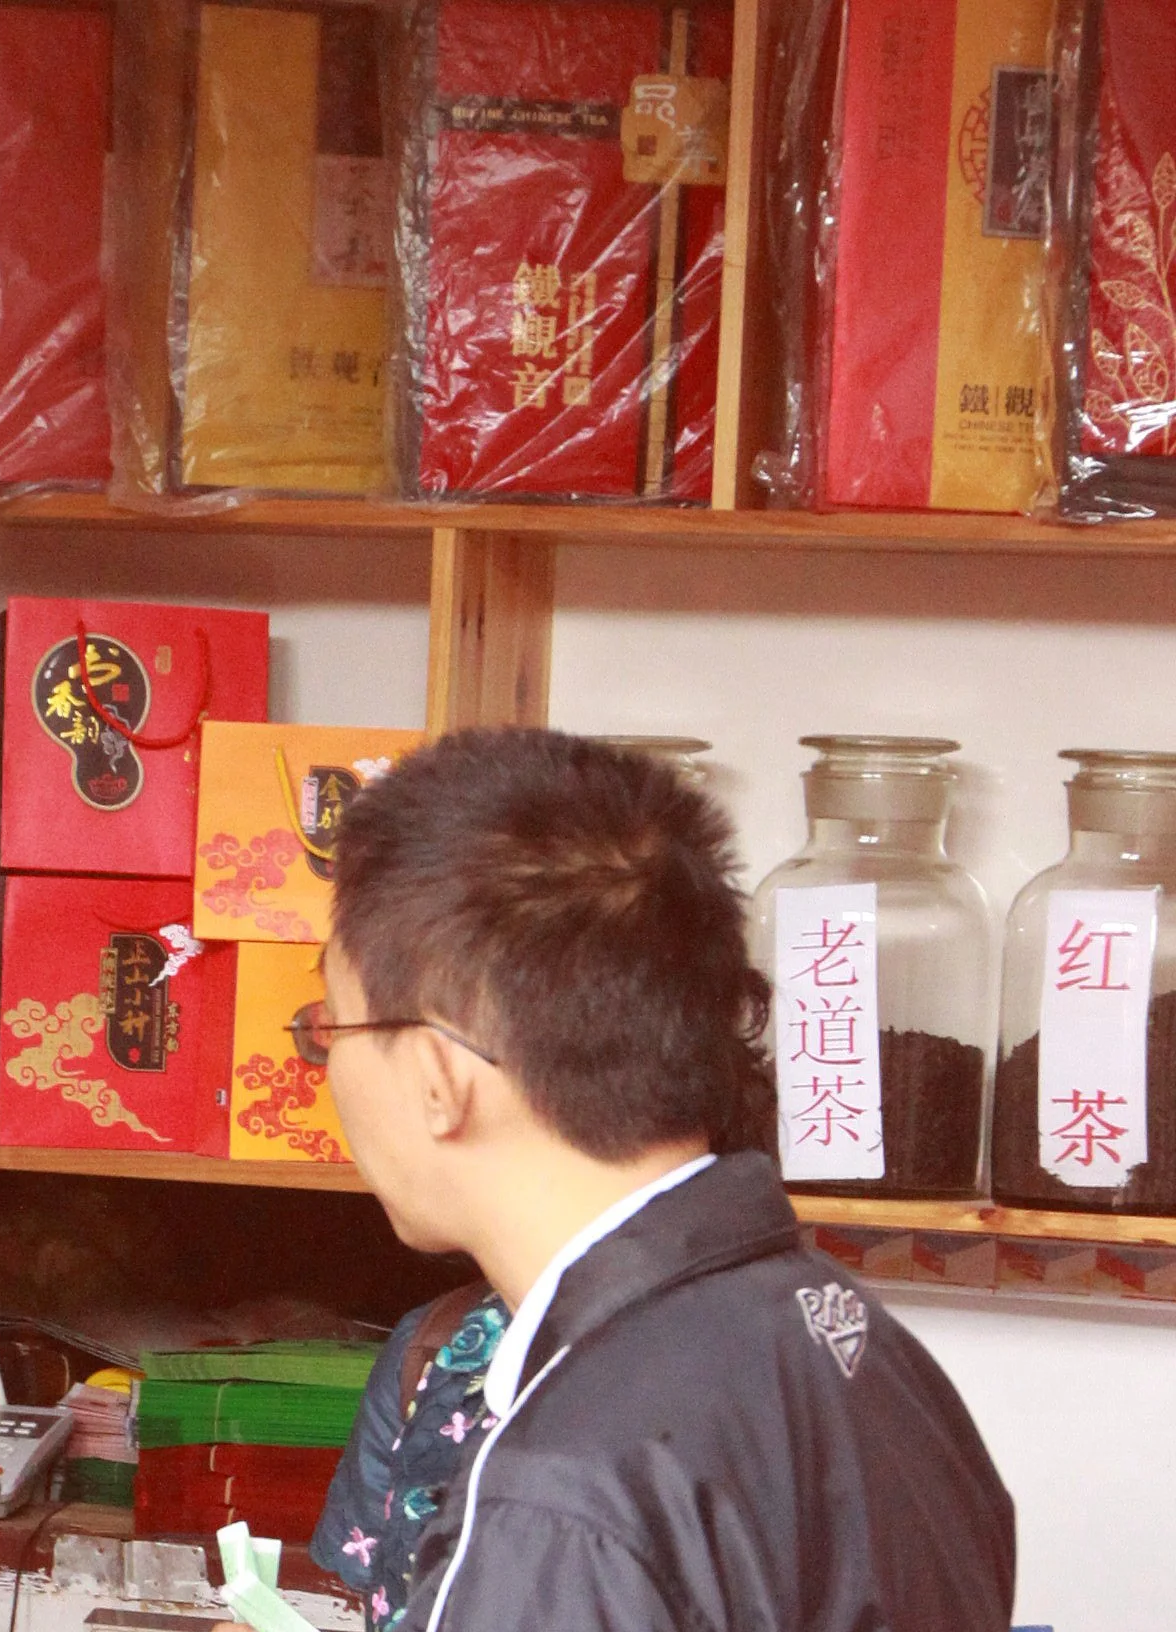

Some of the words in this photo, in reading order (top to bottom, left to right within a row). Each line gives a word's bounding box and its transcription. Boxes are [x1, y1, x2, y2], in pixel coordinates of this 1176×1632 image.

[789, 918, 867, 1147] 老道茶
[1051, 919, 1130, 1167] 红茶
